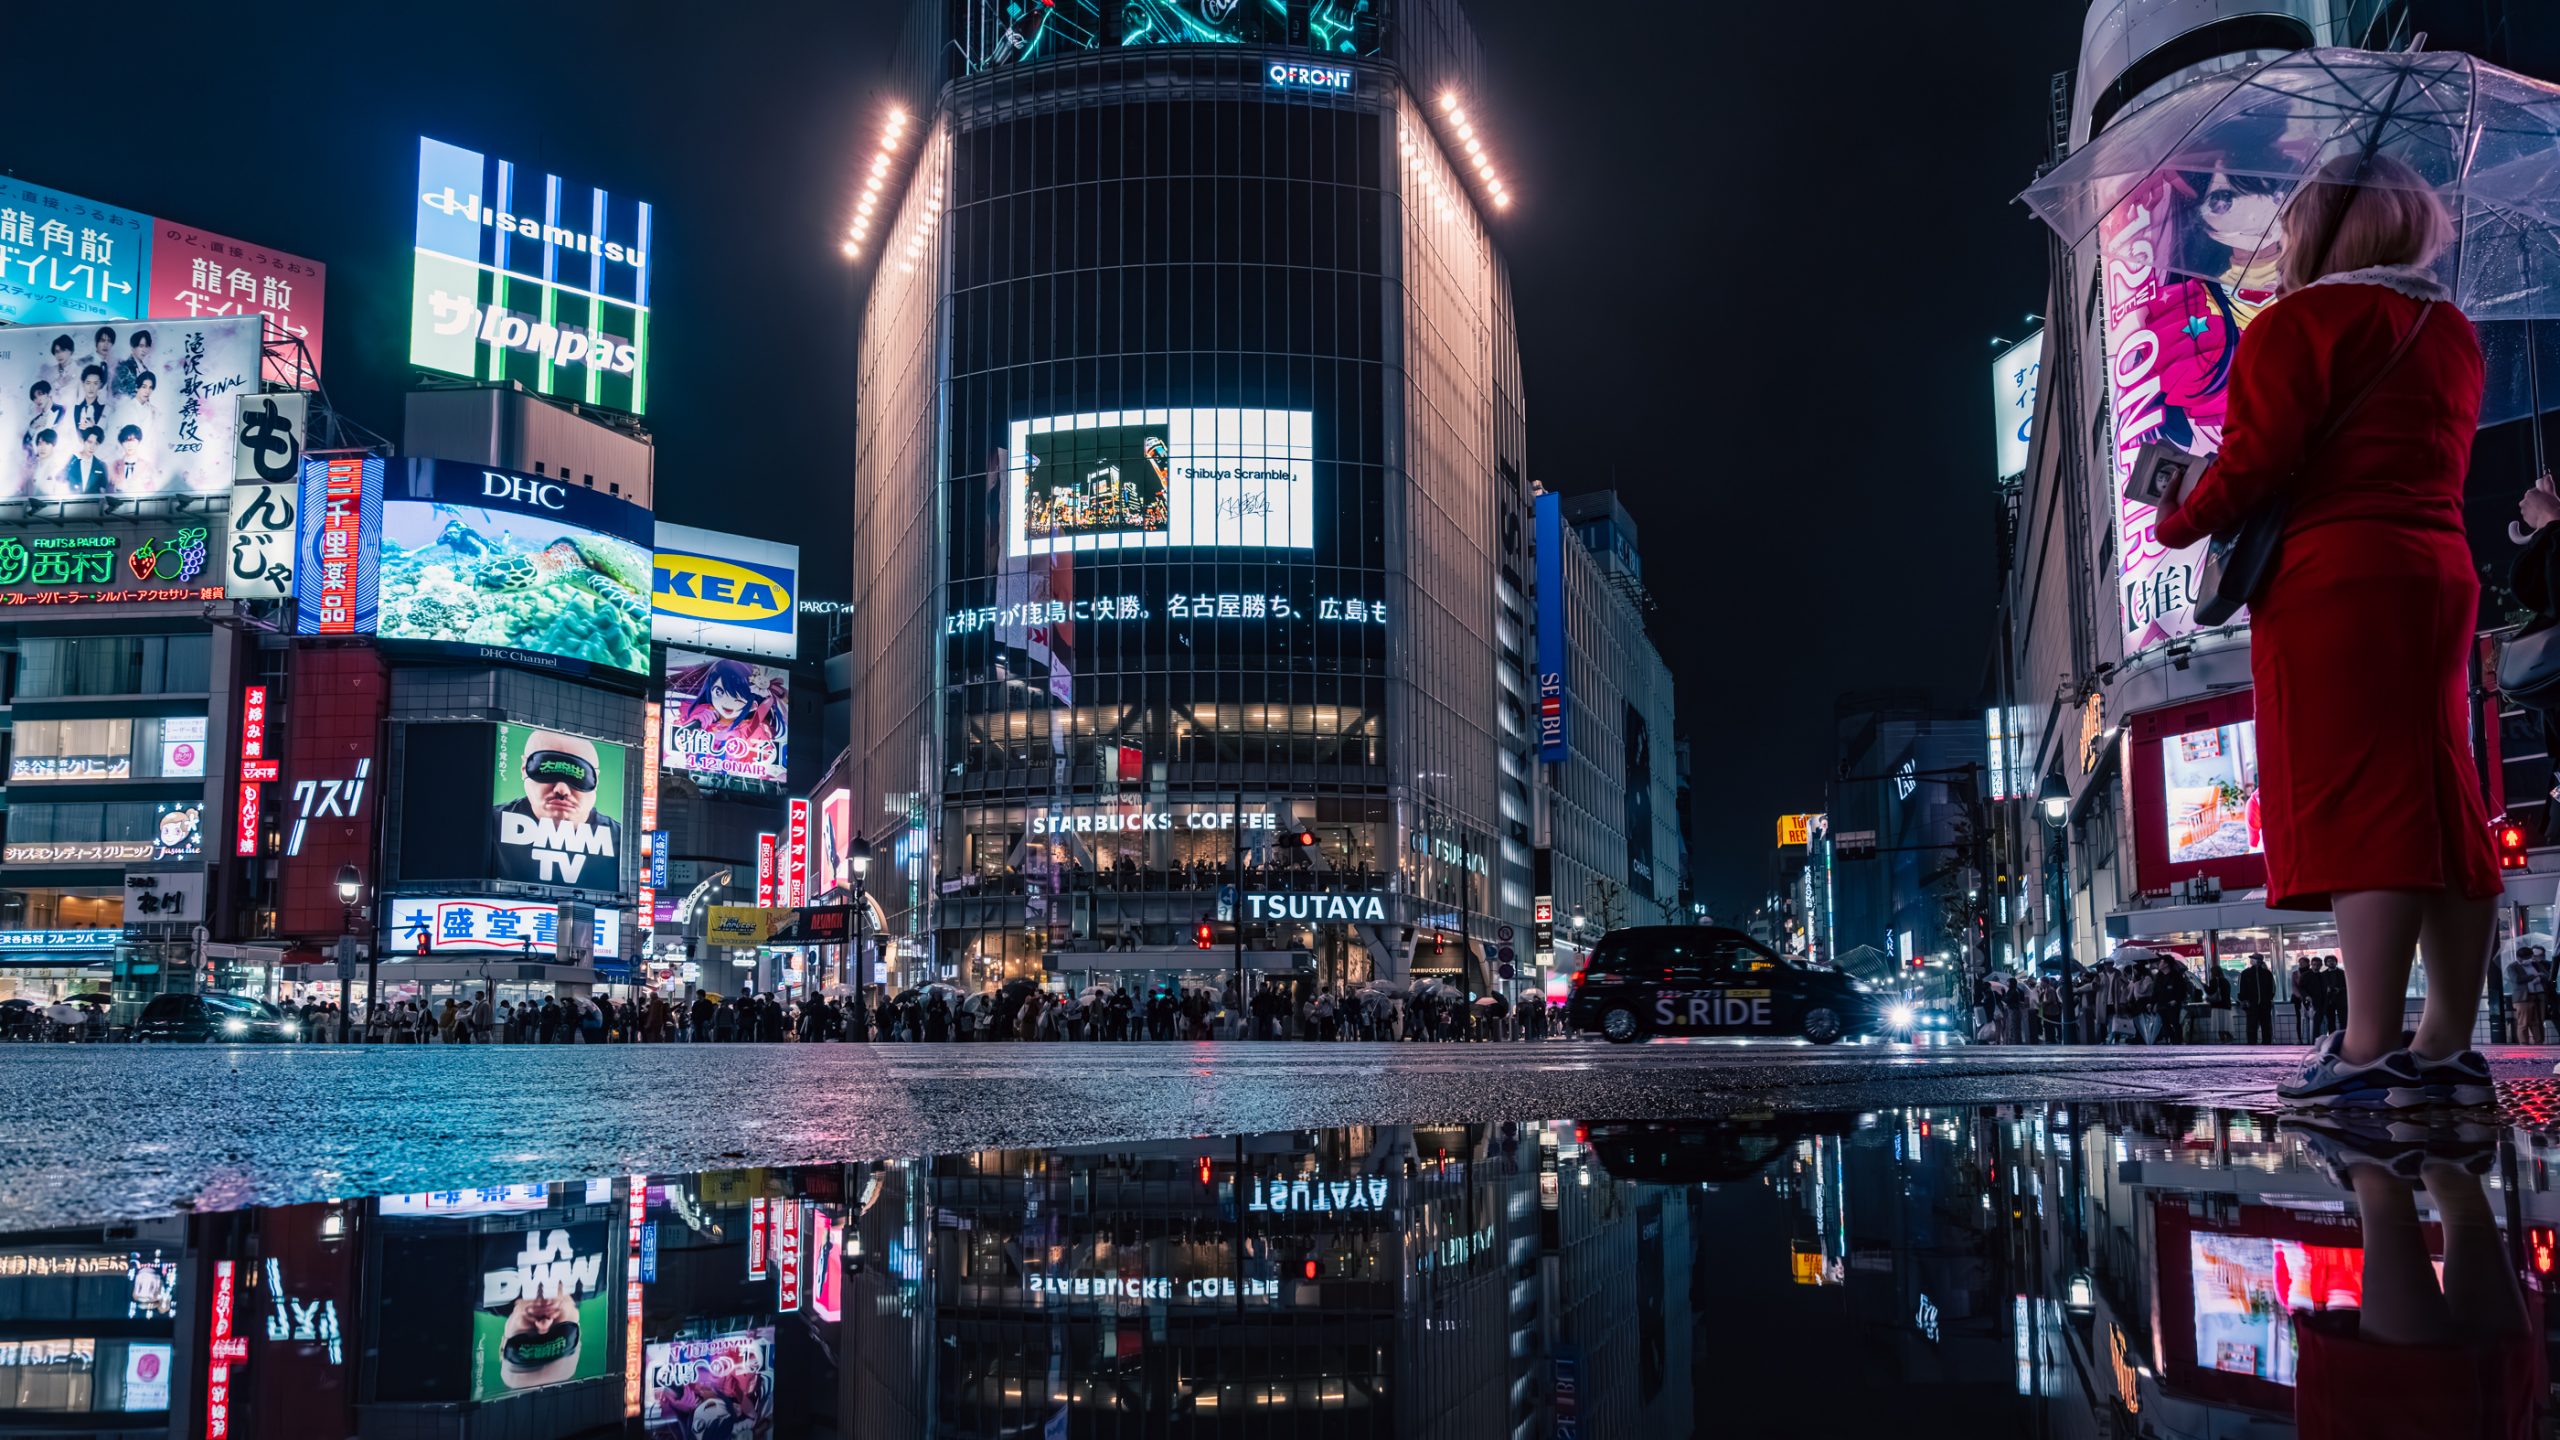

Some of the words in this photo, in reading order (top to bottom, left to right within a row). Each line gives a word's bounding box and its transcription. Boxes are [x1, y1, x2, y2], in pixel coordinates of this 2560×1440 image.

[1270, 65, 1350, 88] QFRONT
[1, 207, 114, 266] 龍角散
[167, 230, 316, 277] のど、直接、うるおう
[192, 257, 293, 312] 龍角散
[202, 375, 247, 399] FINAL
[231, 398, 299, 594] もんじゃ
[482, 471, 566, 509] DHC
[34, 536, 116, 547] FRUITS&PARLOR
[319, 465, 352, 624] 三千里薬品
[31, 550, 115, 583] 西村
[1168, 593, 1301, 619] 名古屋勝ち、
[1319, 597, 1386, 623] 広島も
[480, 648, 507, 660] DHC
[510, 651, 557, 666] Channel
[246, 690, 263, 756] お好み焼
[1541, 673, 1561, 746] SEIBU
[239, 785, 257, 852] もんじゃ焼
[501, 810, 615, 857] DMM
[1033, 813, 1172, 834] STARBUCKS
[1187, 813, 1276, 830] COFFEE
[154, 846, 202, 861] Jasmine
[792, 808, 806, 872] カラオケ
[1435, 838, 1487, 876] TSUAYA
[531, 849, 587, 884] TV
[1633, 859, 1652, 881] CHANEL
[1804, 866, 1813, 908] KARAOKE
[1248, 894, 1385, 920] TSUTAYA
[1886, 928, 1895, 957] ZARA
[1655, 998, 1772, 1025] S.RIDE
